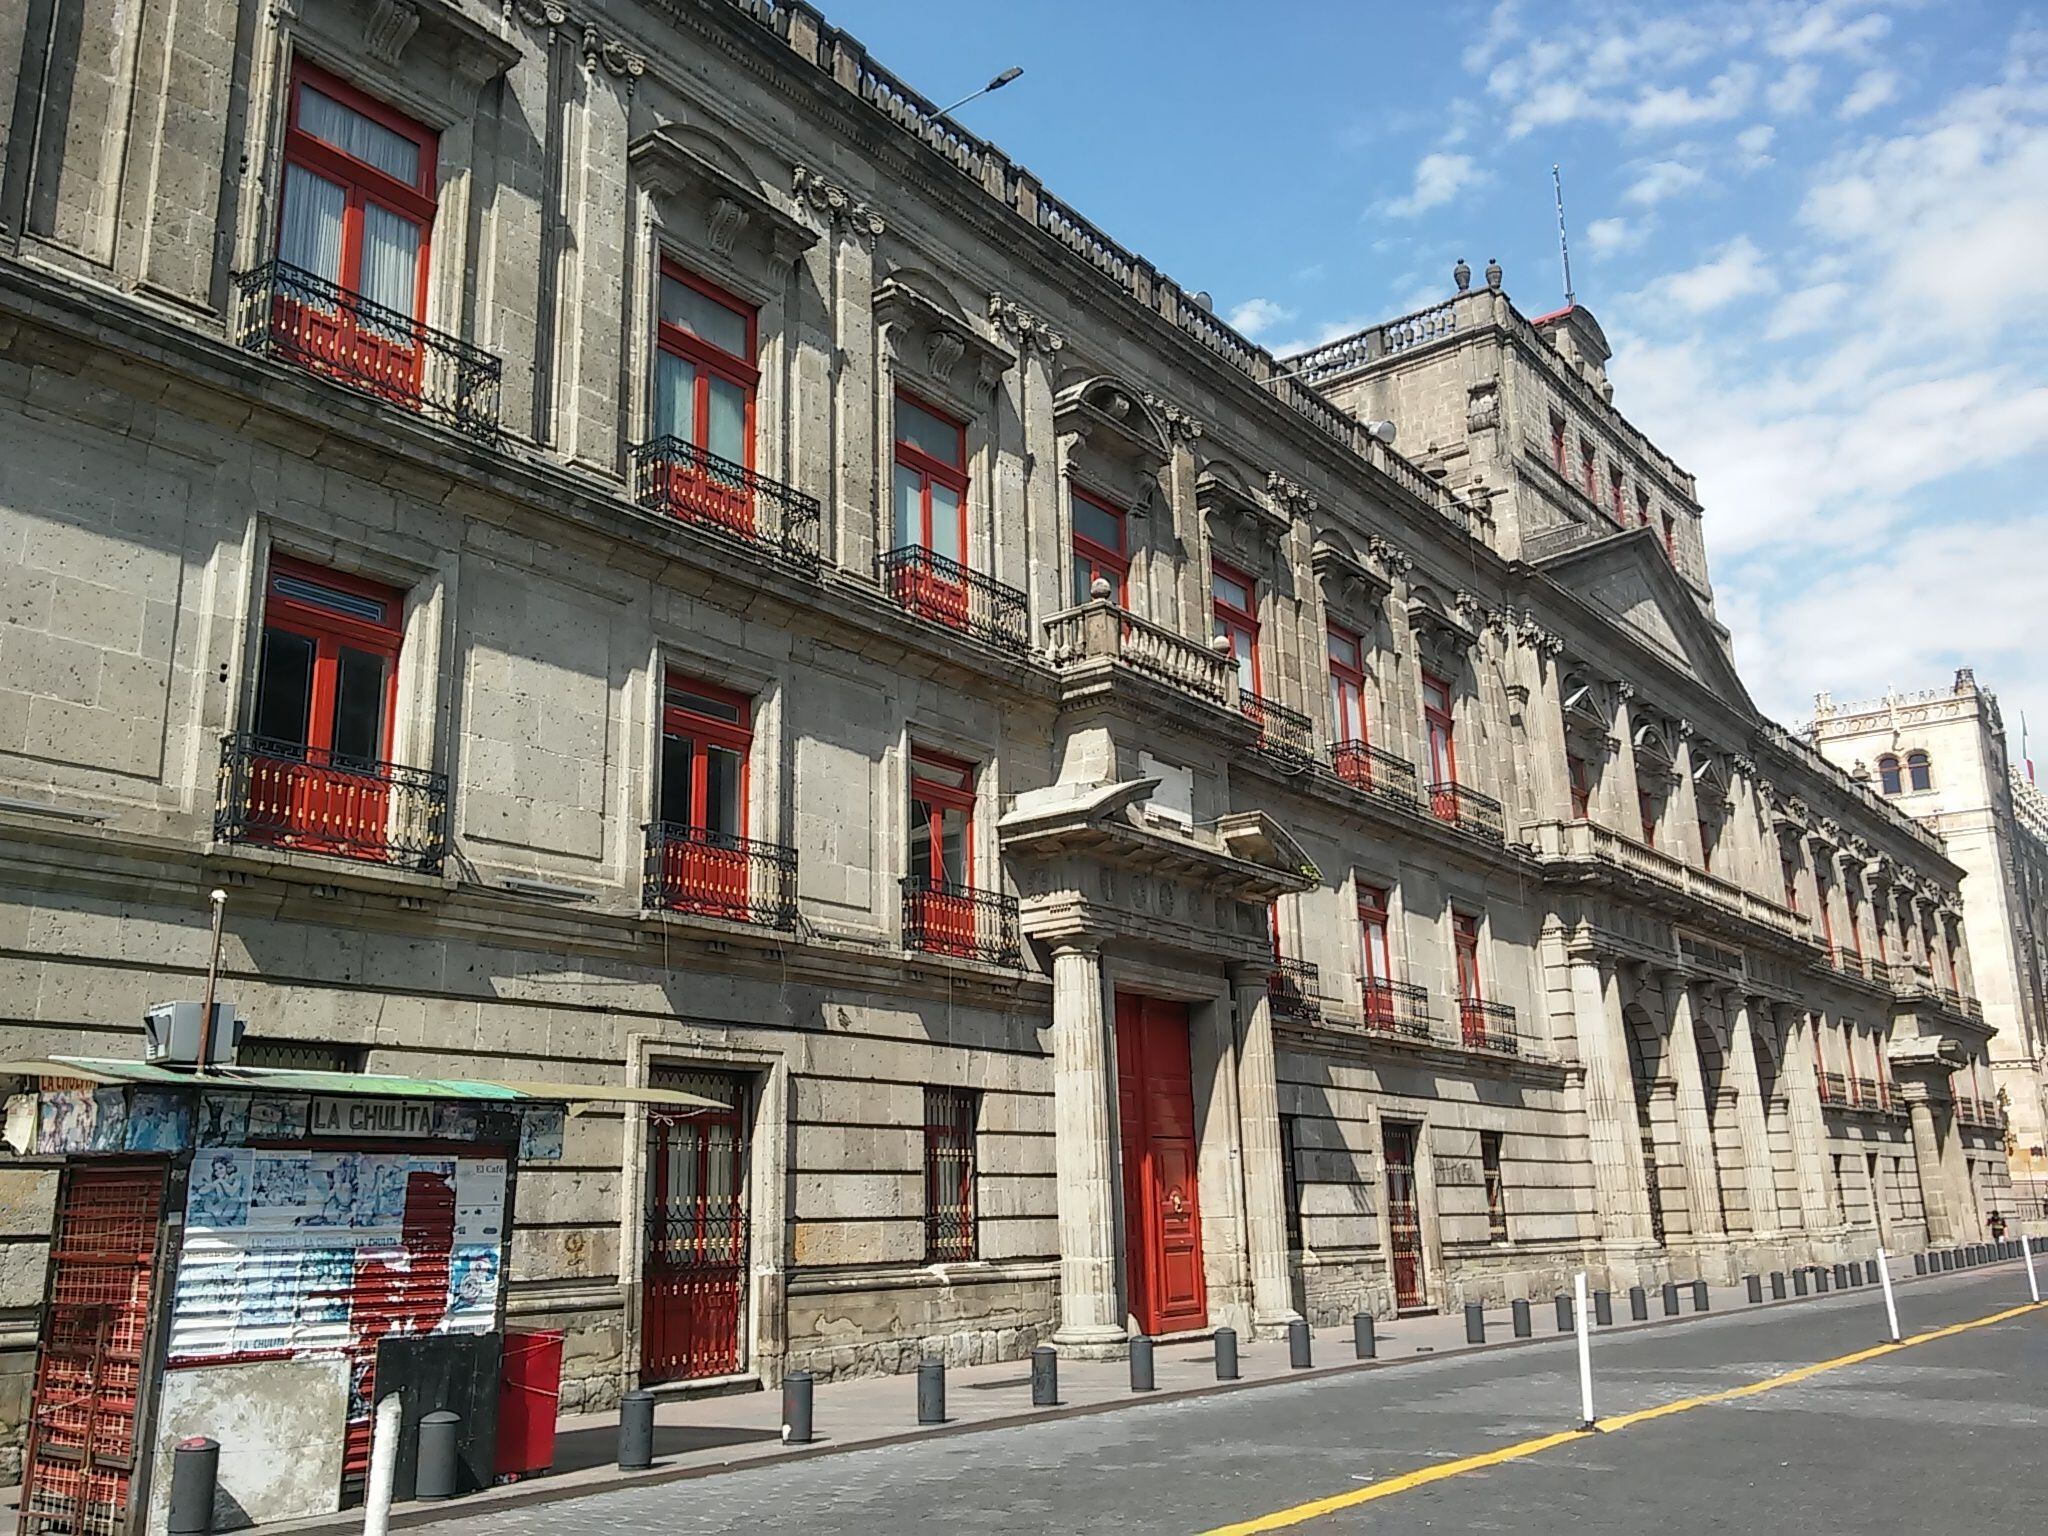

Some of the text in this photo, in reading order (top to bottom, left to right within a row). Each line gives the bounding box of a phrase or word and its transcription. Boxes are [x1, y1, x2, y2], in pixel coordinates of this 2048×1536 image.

[41, 1075, 53, 1091] LA
[314, 1102, 340, 1129] LA
[476, 1164, 484, 1173] El
[239, 1340, 249, 1350] LA
